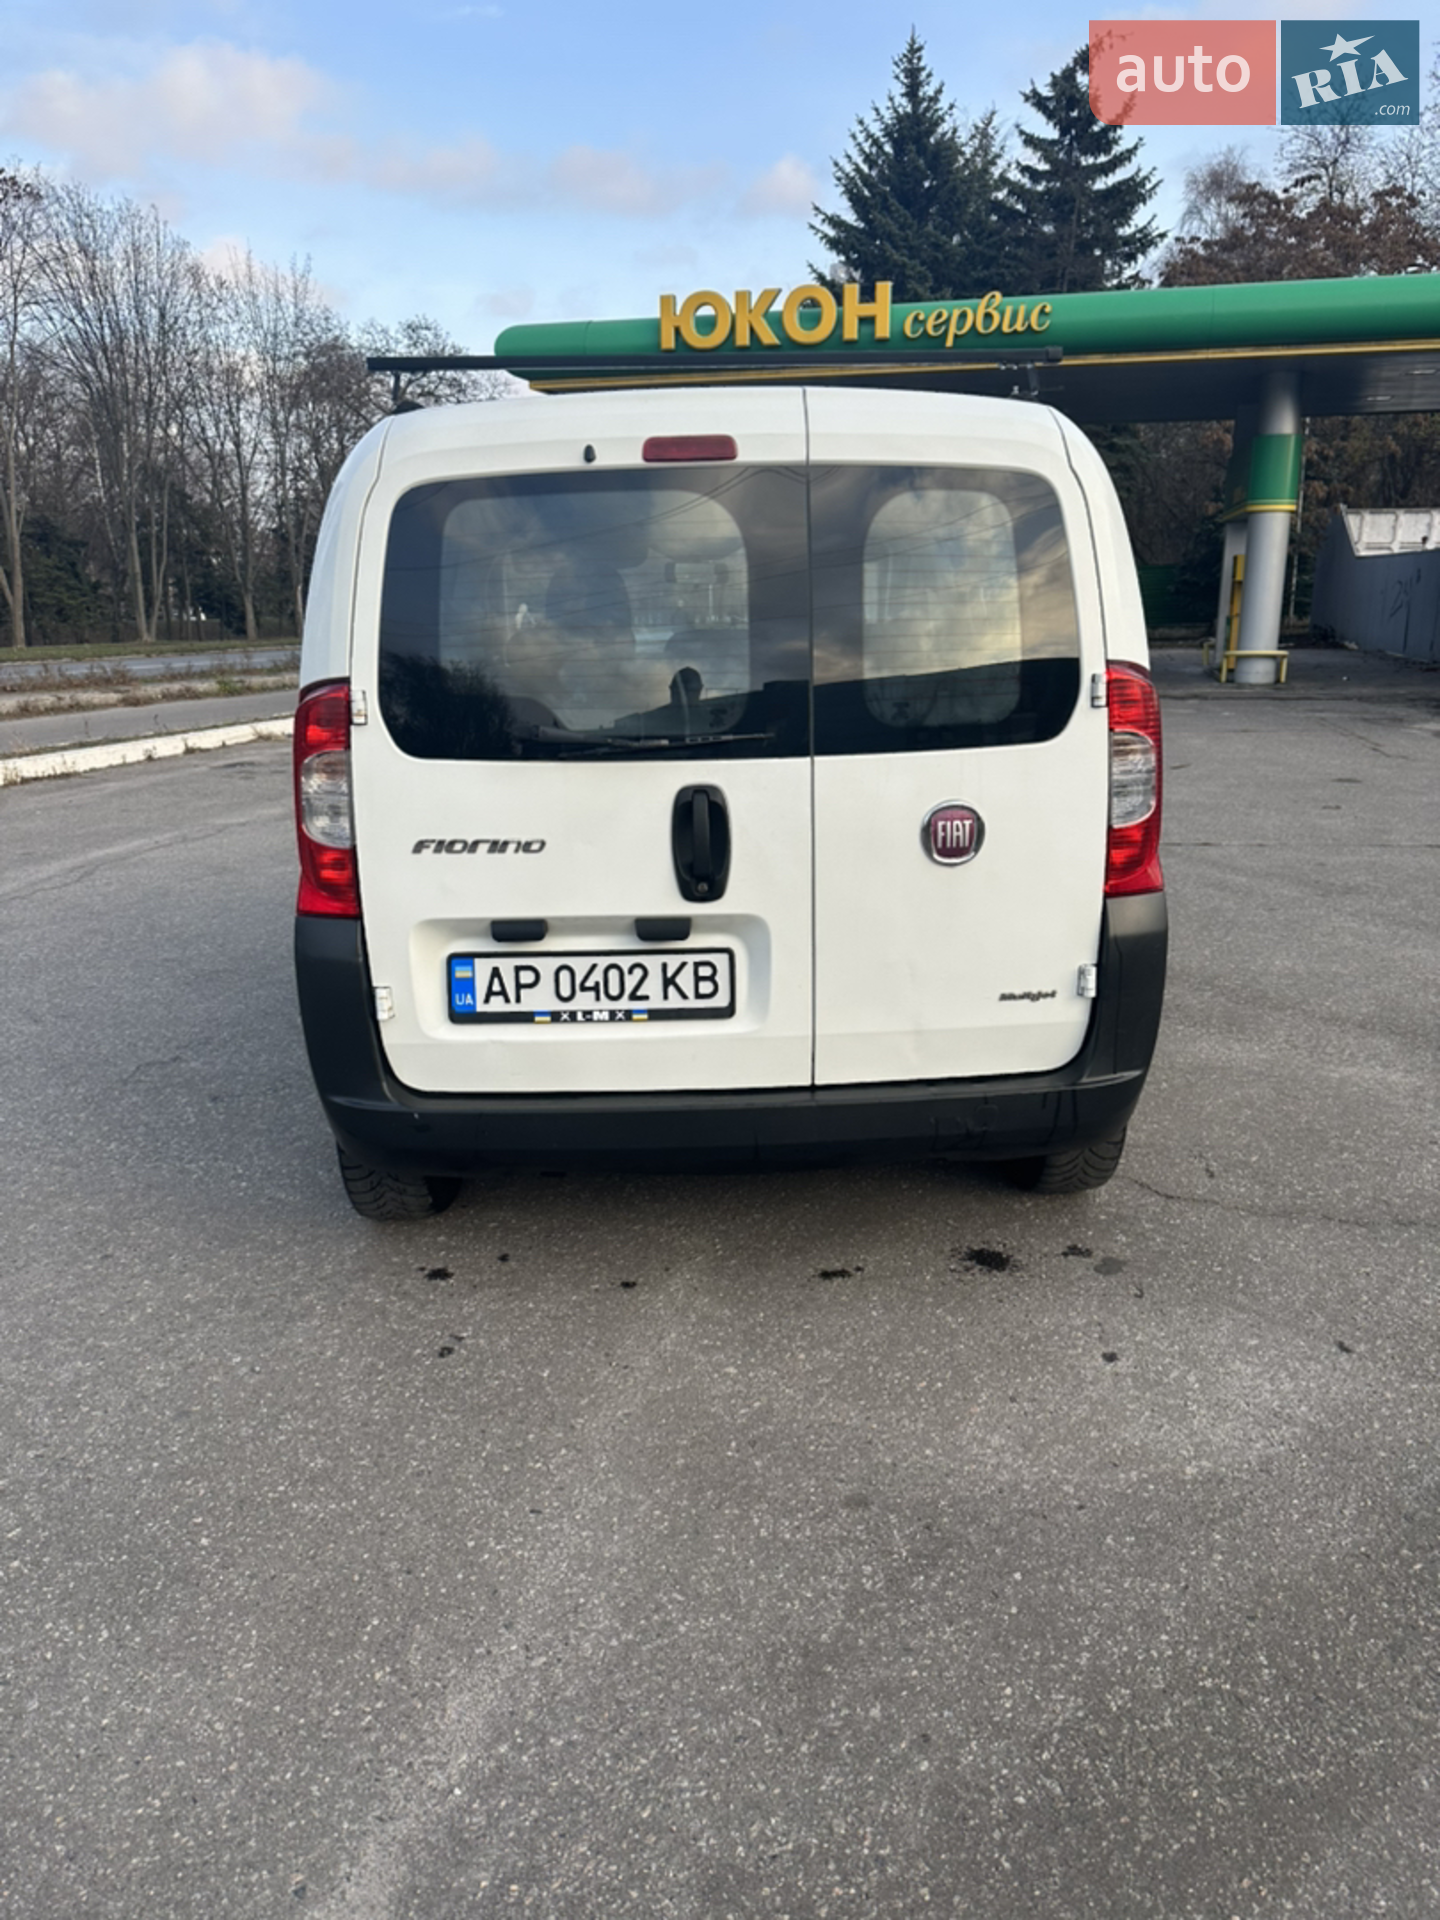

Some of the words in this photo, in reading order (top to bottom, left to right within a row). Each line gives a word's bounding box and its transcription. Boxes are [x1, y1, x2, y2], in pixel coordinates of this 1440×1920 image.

[659, 281, 892, 351] ЮКОН
[903, 291, 1051, 347] сервис
[937, 819, 973, 848] FIAT
[455, 993, 474, 1006] UA
[483, 965, 541, 1004] AP
[554, 962, 650, 1002] 0402
[661, 960, 720, 1000] KB
